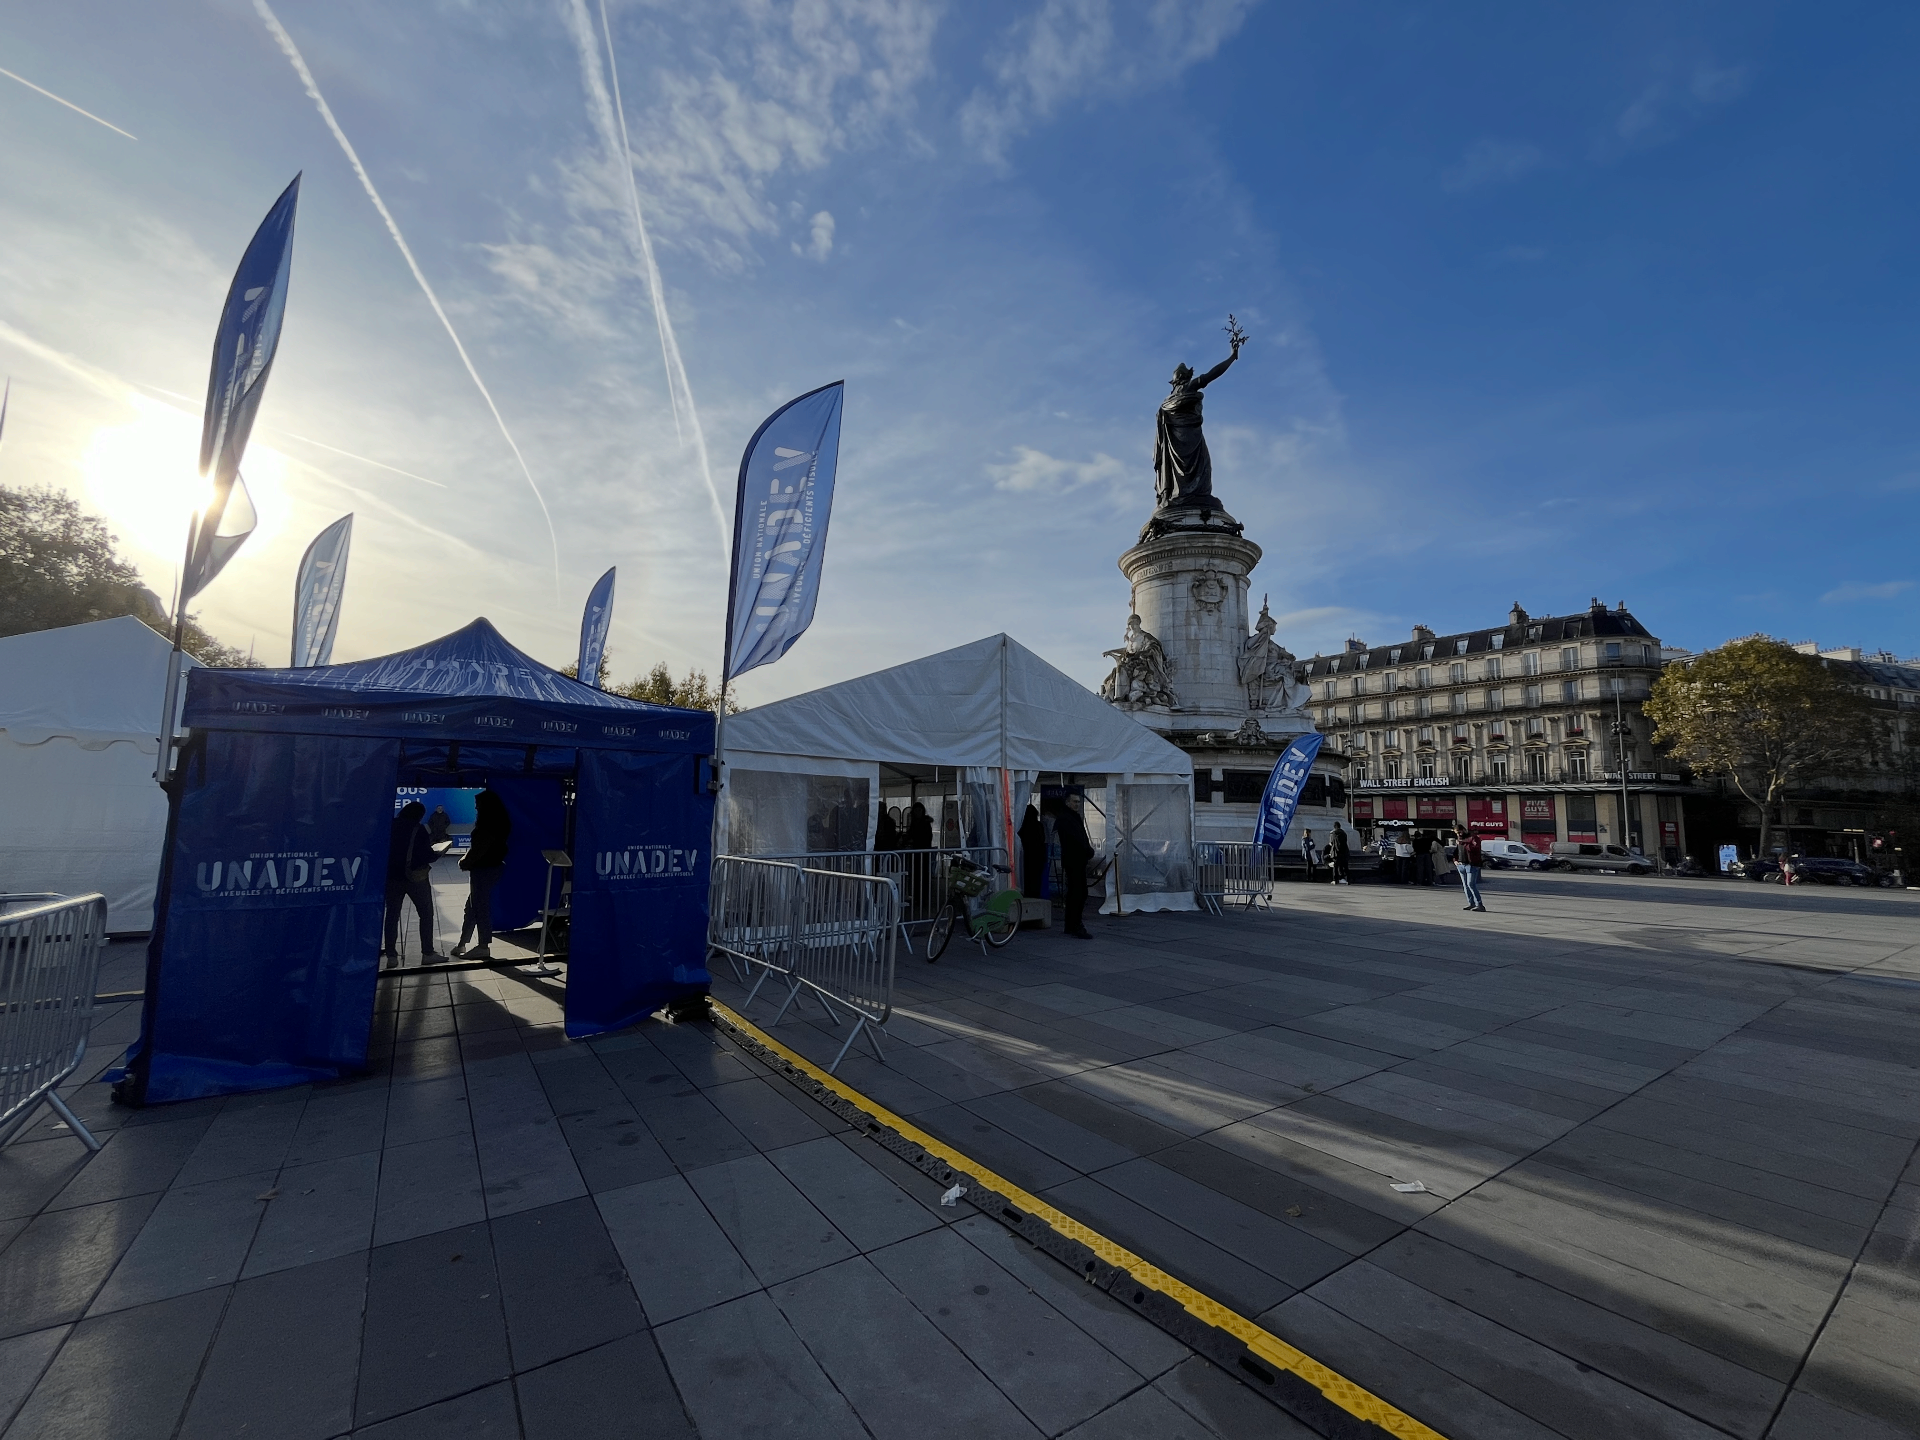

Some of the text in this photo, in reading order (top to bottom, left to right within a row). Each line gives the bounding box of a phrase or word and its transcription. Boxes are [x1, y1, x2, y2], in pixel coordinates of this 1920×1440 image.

[803, 490, 815, 544] DÉFICIENTS
[752, 500, 768, 579] UNION NATIONALE
[232, 701, 286, 714] UNADEV
[321, 708, 370, 719] UNADEV
[401, 712, 446, 723] UNADEV
[474, 716, 514, 727] UNADEV
[540, 721, 578, 731] UNADEV
[602, 726, 636, 736] UNADEV
[658, 730, 690, 739] UNADEV
[1628, 772, 1657, 780] STREET
[1360, 777, 1449, 788] WALL STREET ENGLISH
[595, 848, 698, 875] UNADEV
[196, 856, 362, 891] UNADEV
[219, 889, 261, 897] AVEUGLES
[275, 886, 321, 895] DÉFICIENTS
